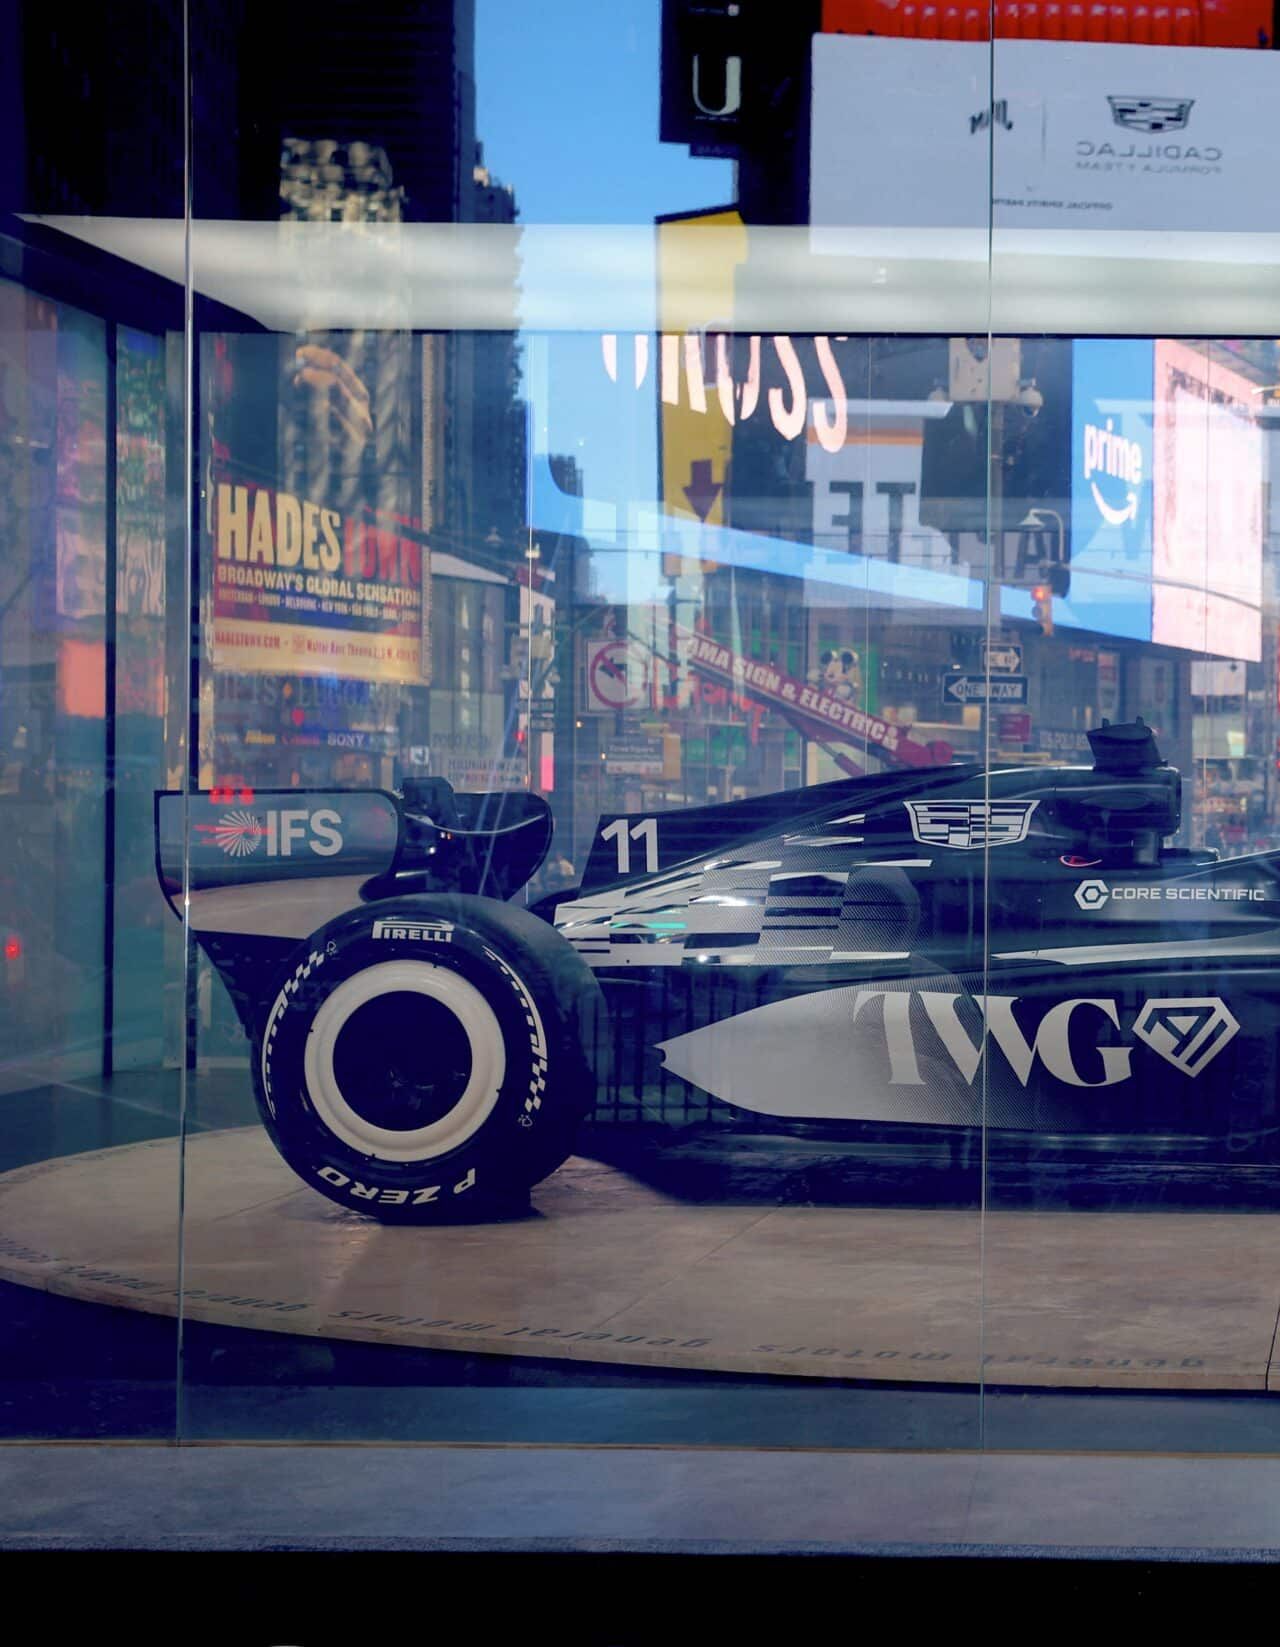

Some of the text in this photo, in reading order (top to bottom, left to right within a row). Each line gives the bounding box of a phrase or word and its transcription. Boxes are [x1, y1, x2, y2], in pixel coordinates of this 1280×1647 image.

[1083, 418, 1143, 485] prime
[217, 564, 305, 593] BROADWAY'S
[305, 576, 354, 599] GLOBAL
[956, 683, 1020, 699] ONE WAY
[781, 682, 797, 703] &
[799, 687, 886, 741] ELECTRIC
[327, 734, 366, 746] SONY
[265, 808, 344, 857] IFS
[601, 818, 659, 873] 11
[1111, 887, 1265, 901] CORE SCIENTIFIC
[372, 920, 455, 943] PIRELLI
[852, 990, 1135, 1088] TWG
[317, 1166, 476, 1205] P ZERO
